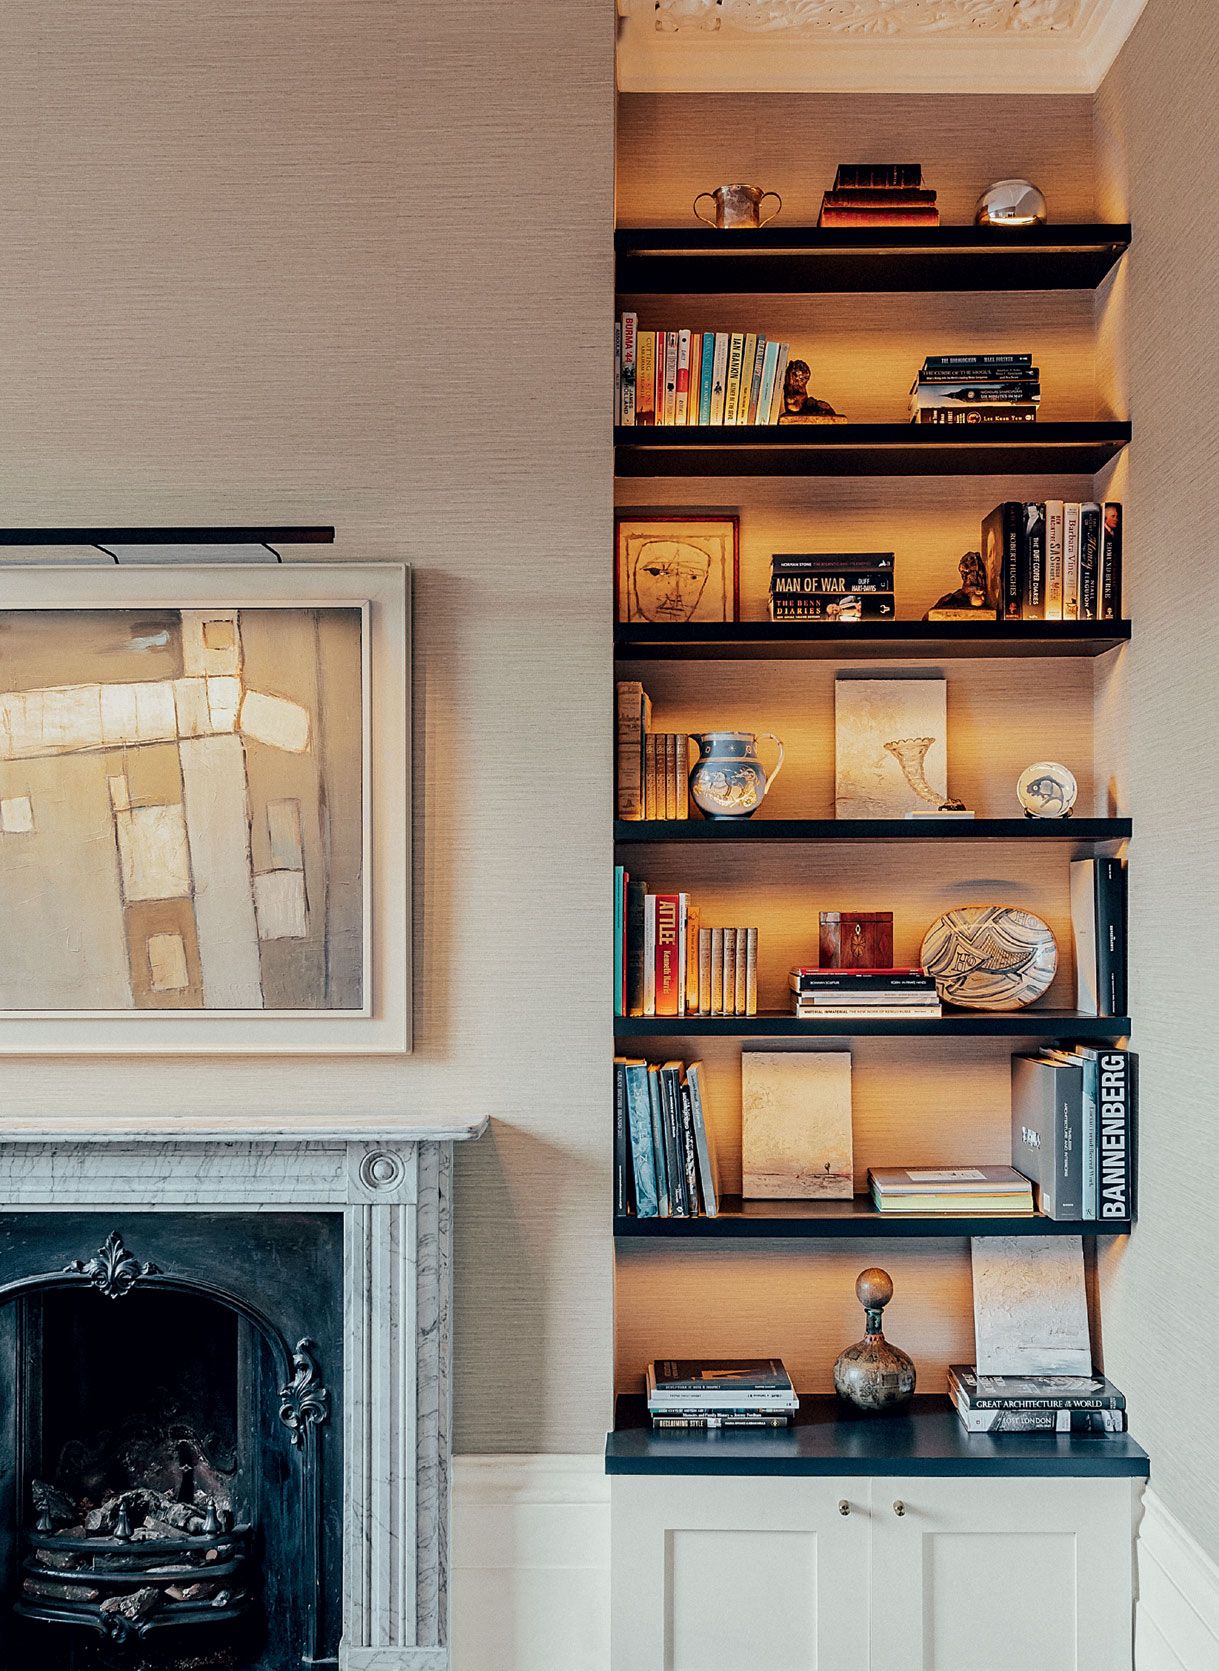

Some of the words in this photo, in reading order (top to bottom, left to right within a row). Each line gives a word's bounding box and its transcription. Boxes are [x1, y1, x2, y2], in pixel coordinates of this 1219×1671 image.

[625, 318, 634, 350] BURMA
[732, 338, 742, 351] IAN
[756, 340, 765, 356] DEAR
[730, 352, 740, 379] RANKIN
[1009, 532, 1017, 562] ROBERT
[1032, 537, 1040, 548] THE
[1068, 520, 1077, 553] Barbara
[1032, 549, 1040, 562] DUFF
[1050, 543, 1061, 562] SAS
[1081, 532, 1097, 570] Money
[1105, 542, 1113, 573] EDMUND
[1032, 562, 1040, 582] COOPER
[1067, 555, 1076, 576] Vine
[776, 578, 801, 592] MAN
[804, 578, 818, 592] OF
[821, 577, 845, 592] WAR
[1009, 564, 1017, 596] HUGHES
[1105, 574, 1113, 599] BURKE
[1032, 582, 1040, 605] DIARIES
[776, 607, 821, 615] DIARIES
[659, 900, 676, 945] ATTLEE
[663, 951, 672, 975] Kenneth
[1101, 1055, 1126, 1218] BANNENBERG
[1003, 1400, 1063, 1408] ARCHITECTURE
[1073, 1400, 1103, 1408] WORLD
